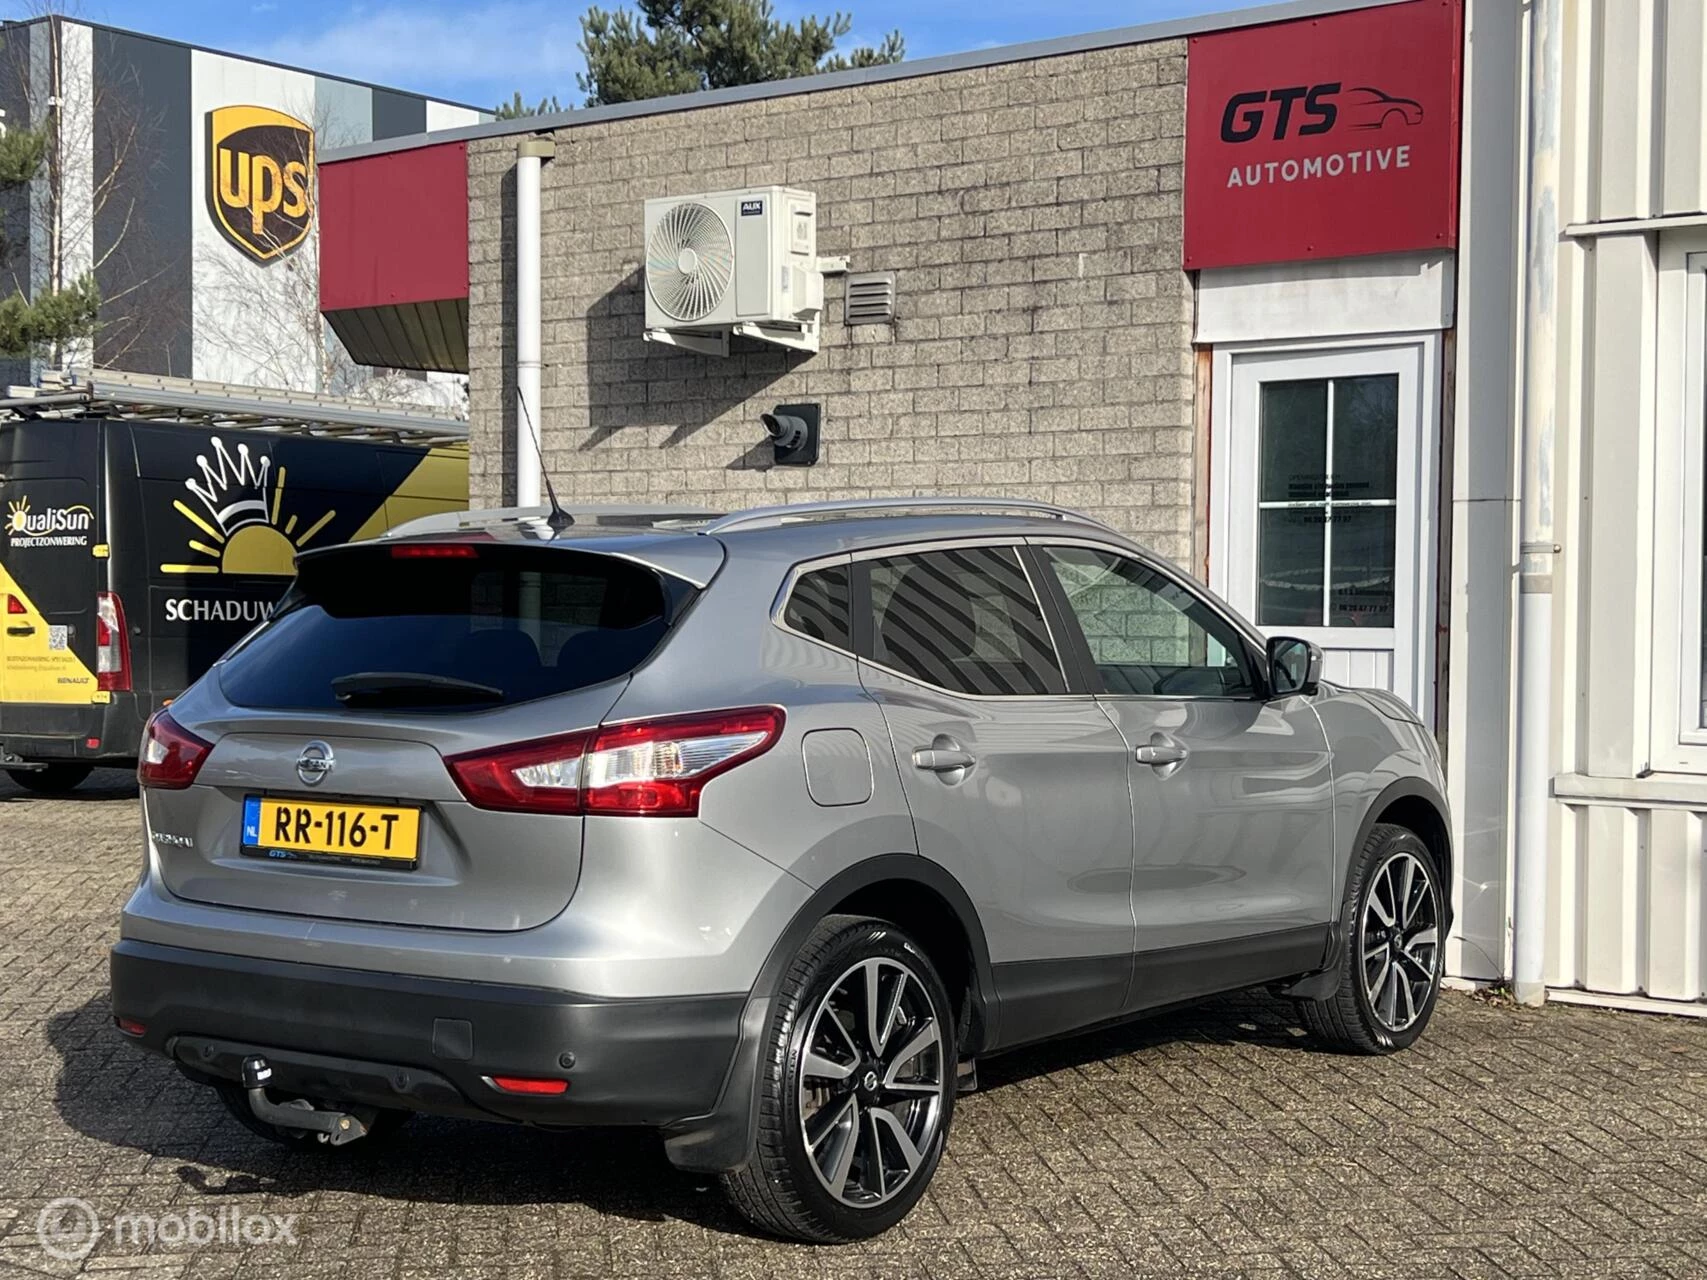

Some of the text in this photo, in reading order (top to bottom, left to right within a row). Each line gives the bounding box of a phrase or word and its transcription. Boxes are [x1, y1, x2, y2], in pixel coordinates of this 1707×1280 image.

[1220, 82, 1342, 143] GTS
[1226, 145, 1411, 189] AUTOMOTIVE
[219, 147, 308, 235] ups
[742, 201, 761, 211] AUX
[11, 506, 90, 537] QualiSun
[10, 535, 88, 548] PROJECTZONWERING
[246, 825, 257, 838] NL
[274, 806, 400, 851] RR-116-T
[268, 850, 287, 858] GTS
